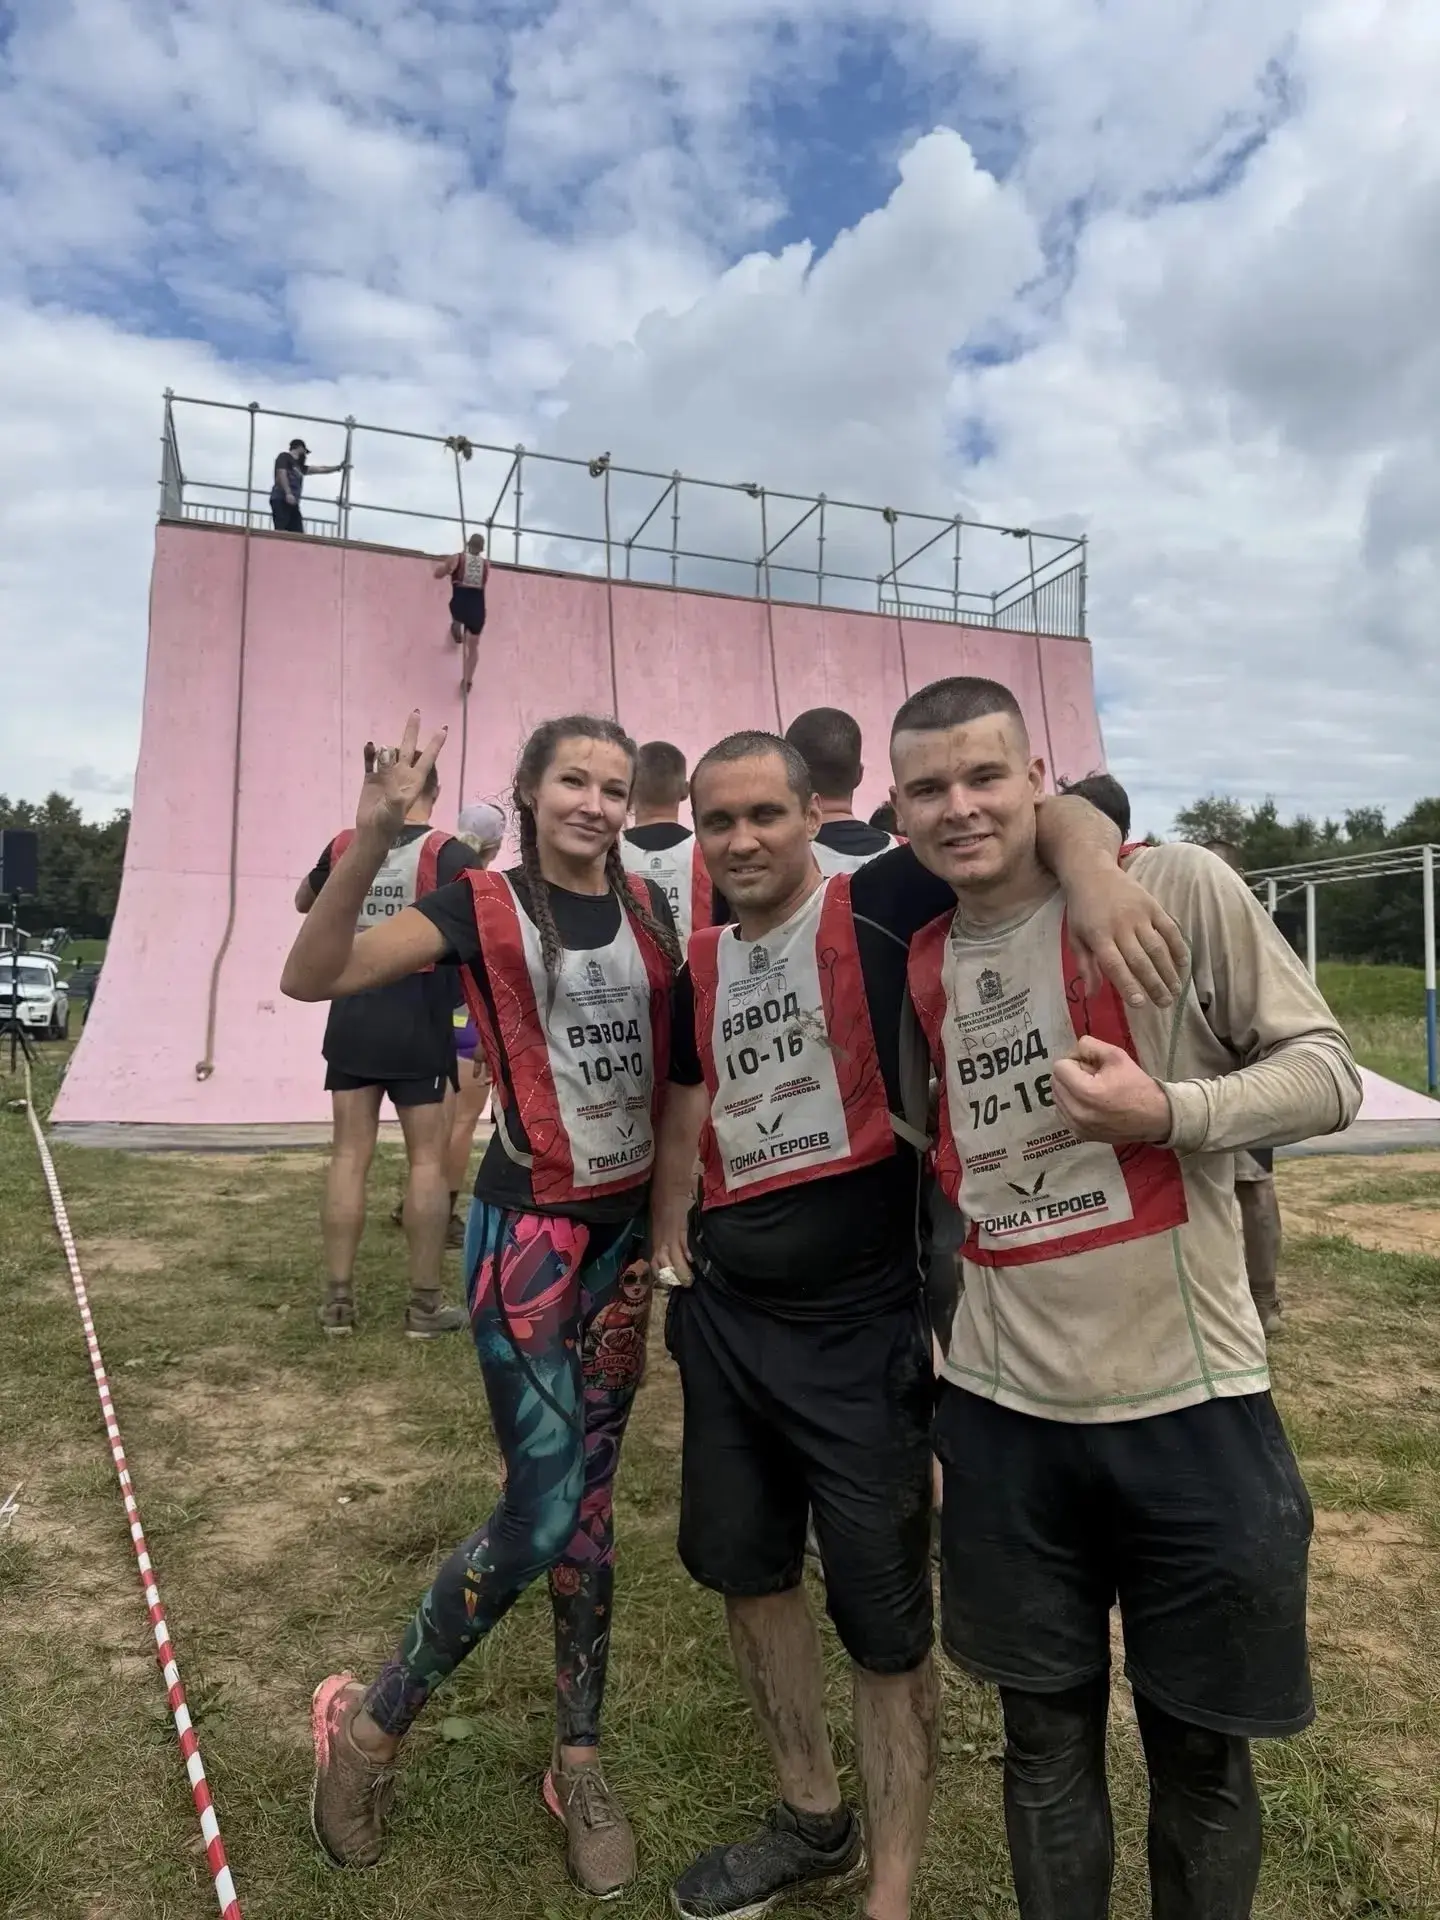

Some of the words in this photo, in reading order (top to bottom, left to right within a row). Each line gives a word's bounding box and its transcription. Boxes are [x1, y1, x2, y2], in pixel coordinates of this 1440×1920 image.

[367, 885, 404, 899] ЗВОД
[722, 991, 801, 1042] ВЗВОД
[566, 1019, 642, 1049] ВЗВОД
[578, 1052, 643, 1086] 10-10
[726, 1029, 803, 1080] 10-16
[957, 1028, 1049, 1085] ВЗВОД
[729, 1149, 767, 1173] ГОНКА
[770, 1131, 830, 1158] ГЕРОЕВ
[1023, 1138, 1085, 1162] ПОДМОСКОВЬ
[1026, 1128, 1072, 1148] МОЛОДЕЖ
[588, 1150, 628, 1170] ГОНКА
[1035, 1190, 1108, 1222] ГЕРОЕВ
